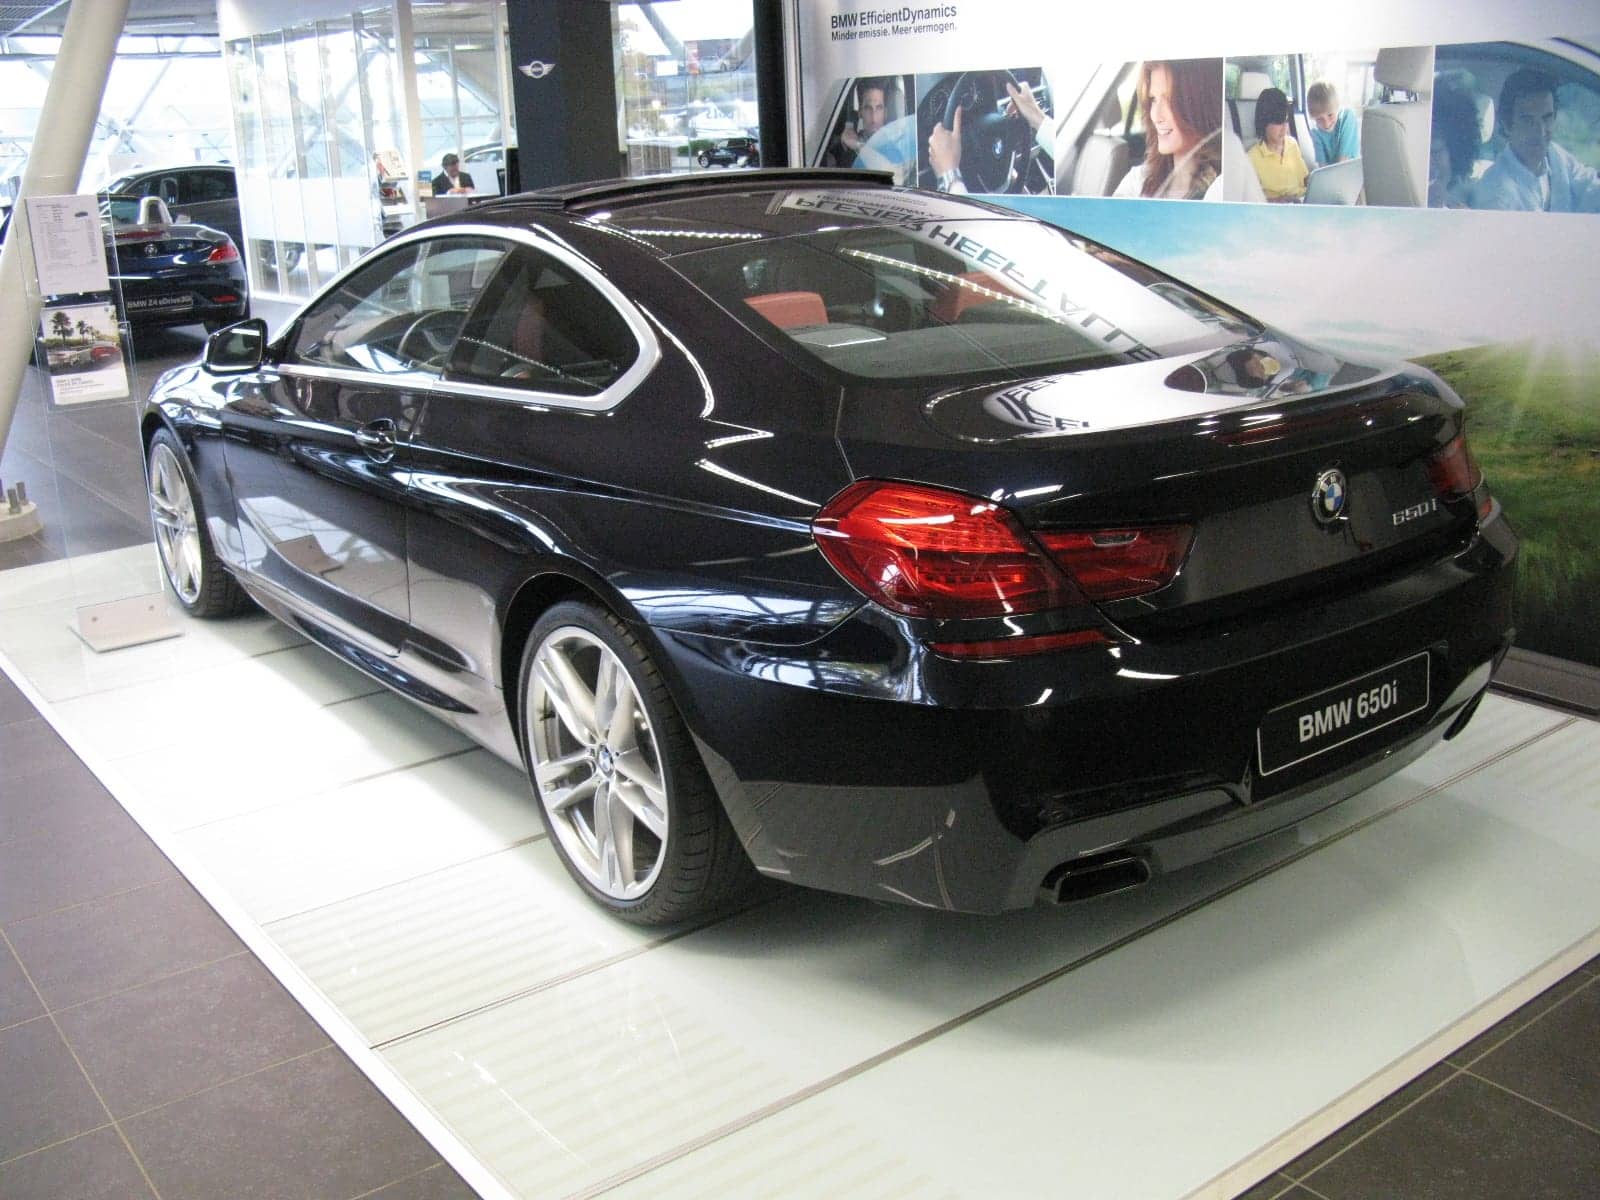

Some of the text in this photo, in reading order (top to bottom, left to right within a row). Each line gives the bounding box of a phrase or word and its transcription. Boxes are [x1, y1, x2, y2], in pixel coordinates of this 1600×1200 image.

[831, 4, 957, 29] BMW EfficientDynamics
[831, 21, 957, 41] Minder emissie. Meer vermogen.
[1392, 498, 1437, 526] 650i
[1299, 679, 1397, 743] BMW 650i
